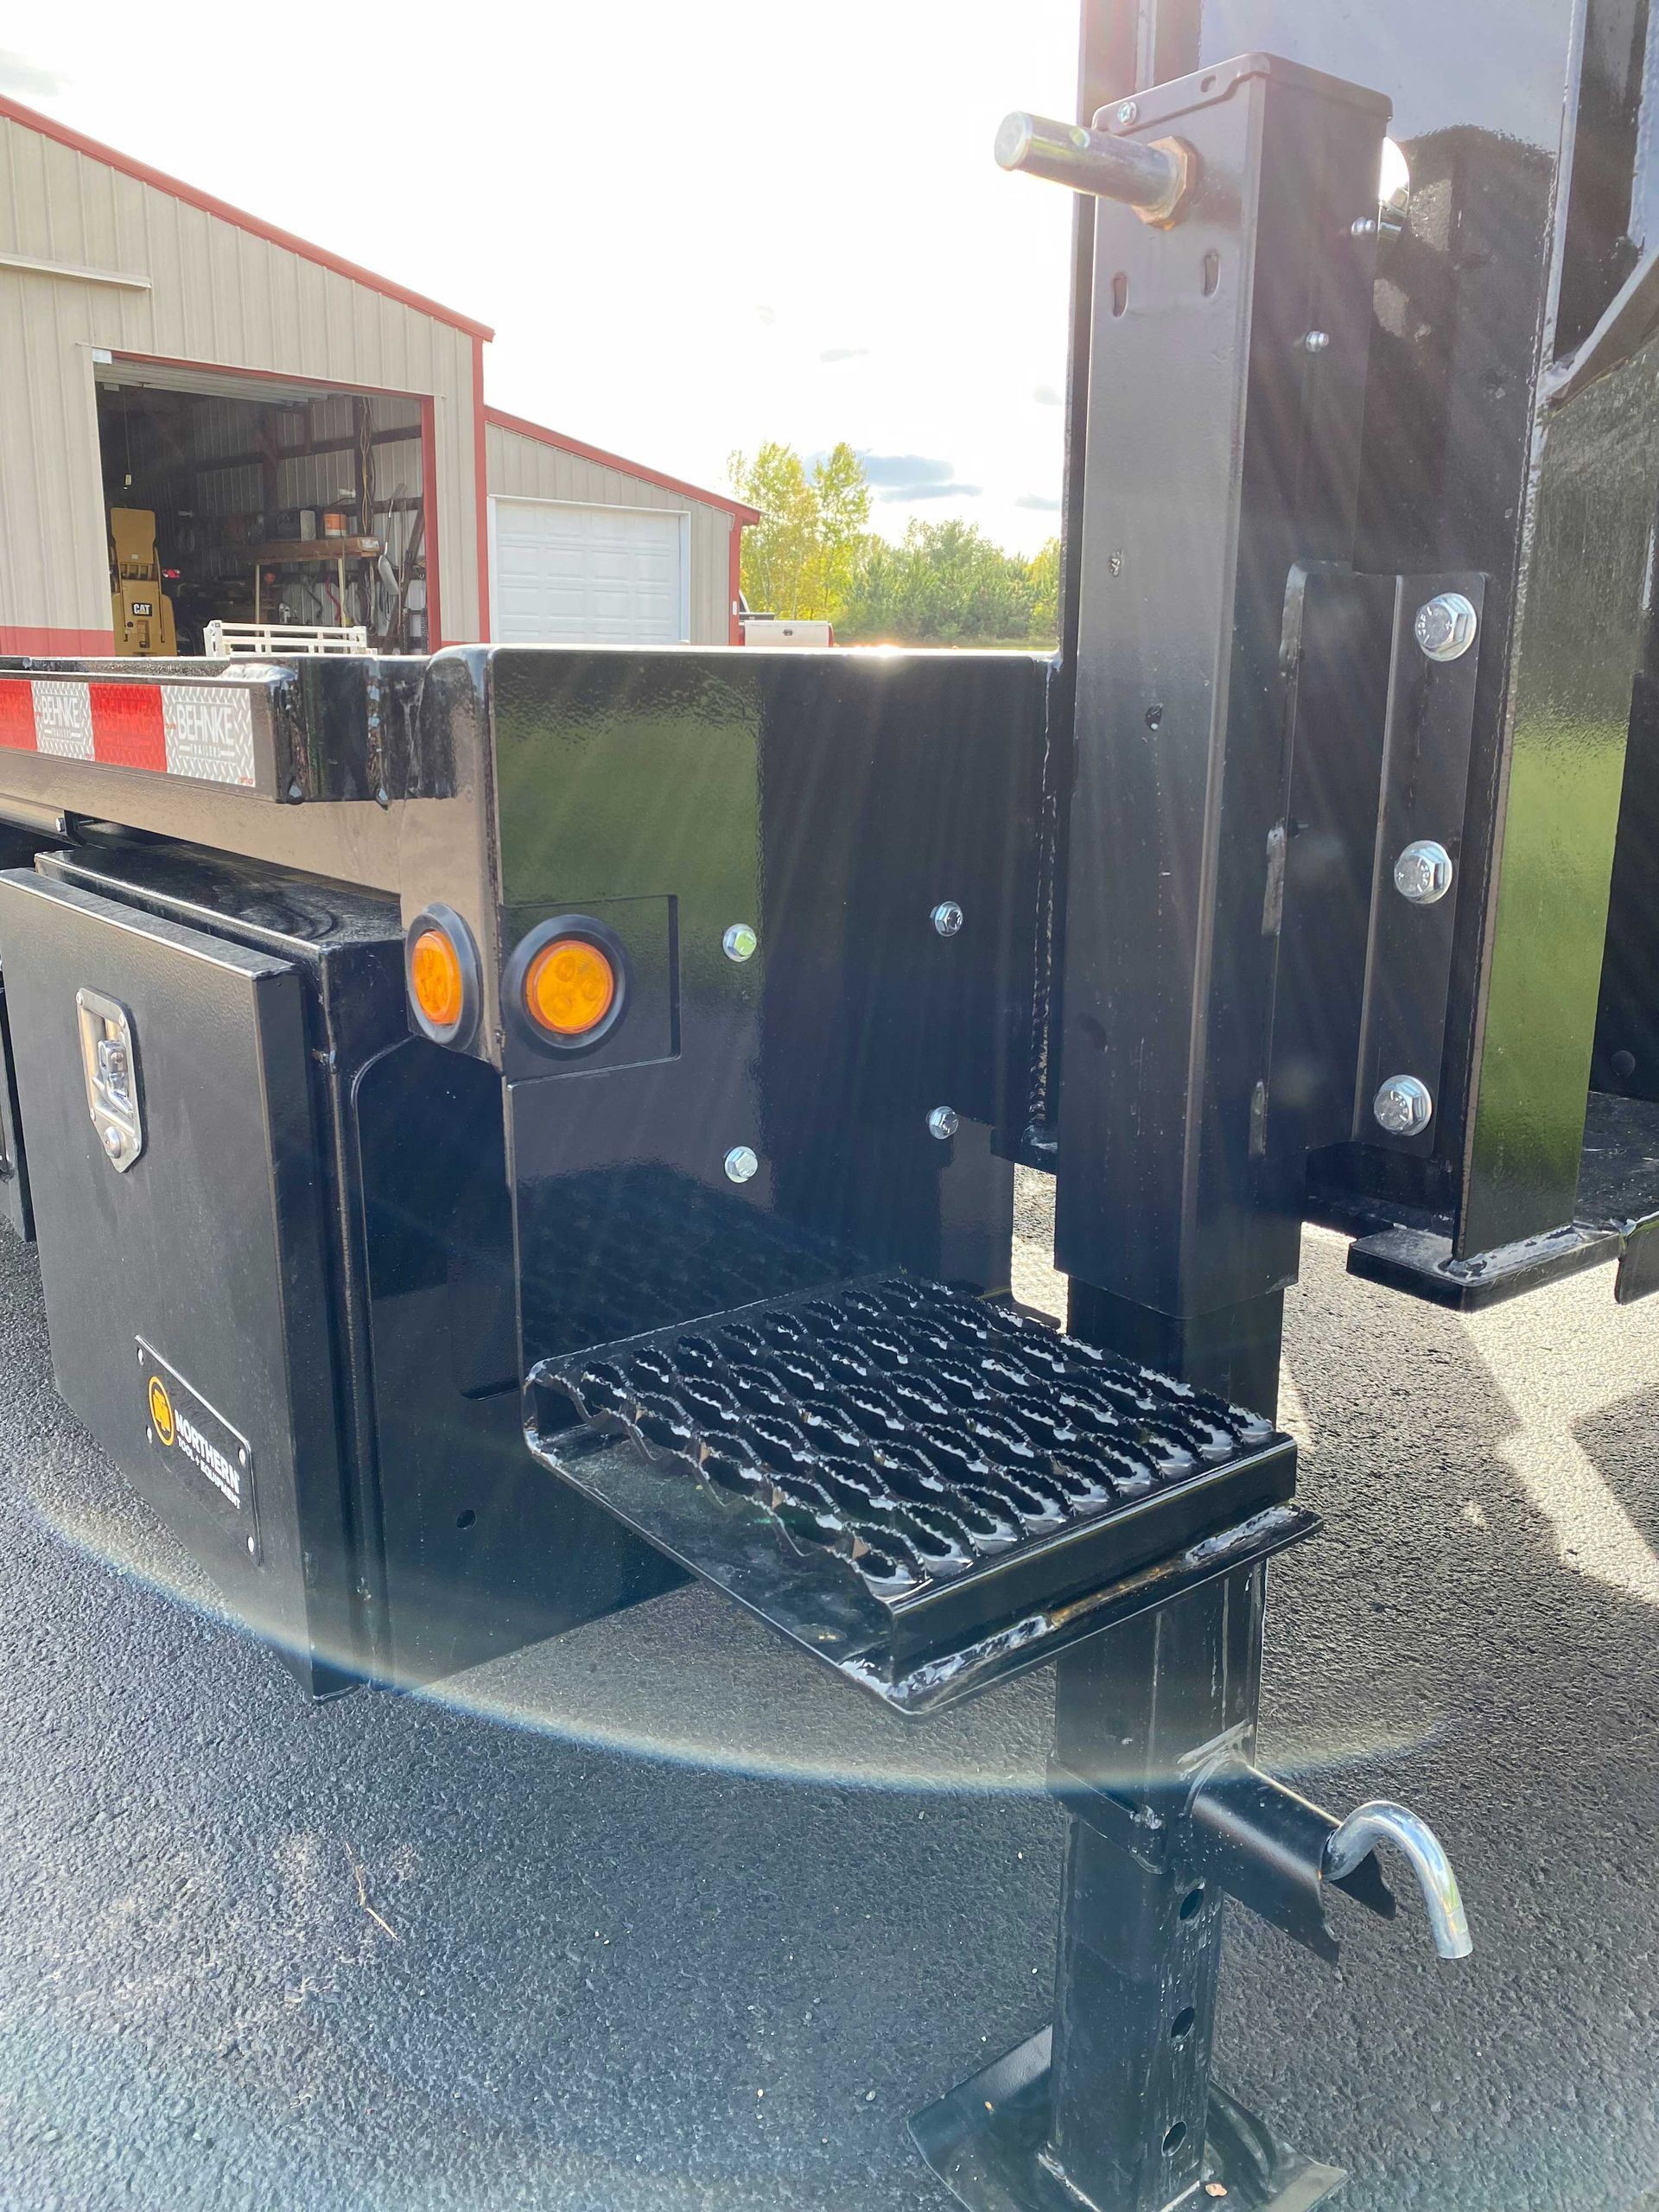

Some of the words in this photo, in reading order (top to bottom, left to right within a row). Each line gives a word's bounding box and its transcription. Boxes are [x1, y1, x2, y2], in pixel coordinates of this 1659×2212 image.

[133, 603, 150, 614] CAT
[41, 696, 80, 728] BEHNKE
[176, 703, 234, 746] BEHNKE
[175, 1408, 240, 1495] NORTHERN
[176, 1434, 195, 1462] TOOL
[200, 1459, 241, 1510] EQUIPMENT
